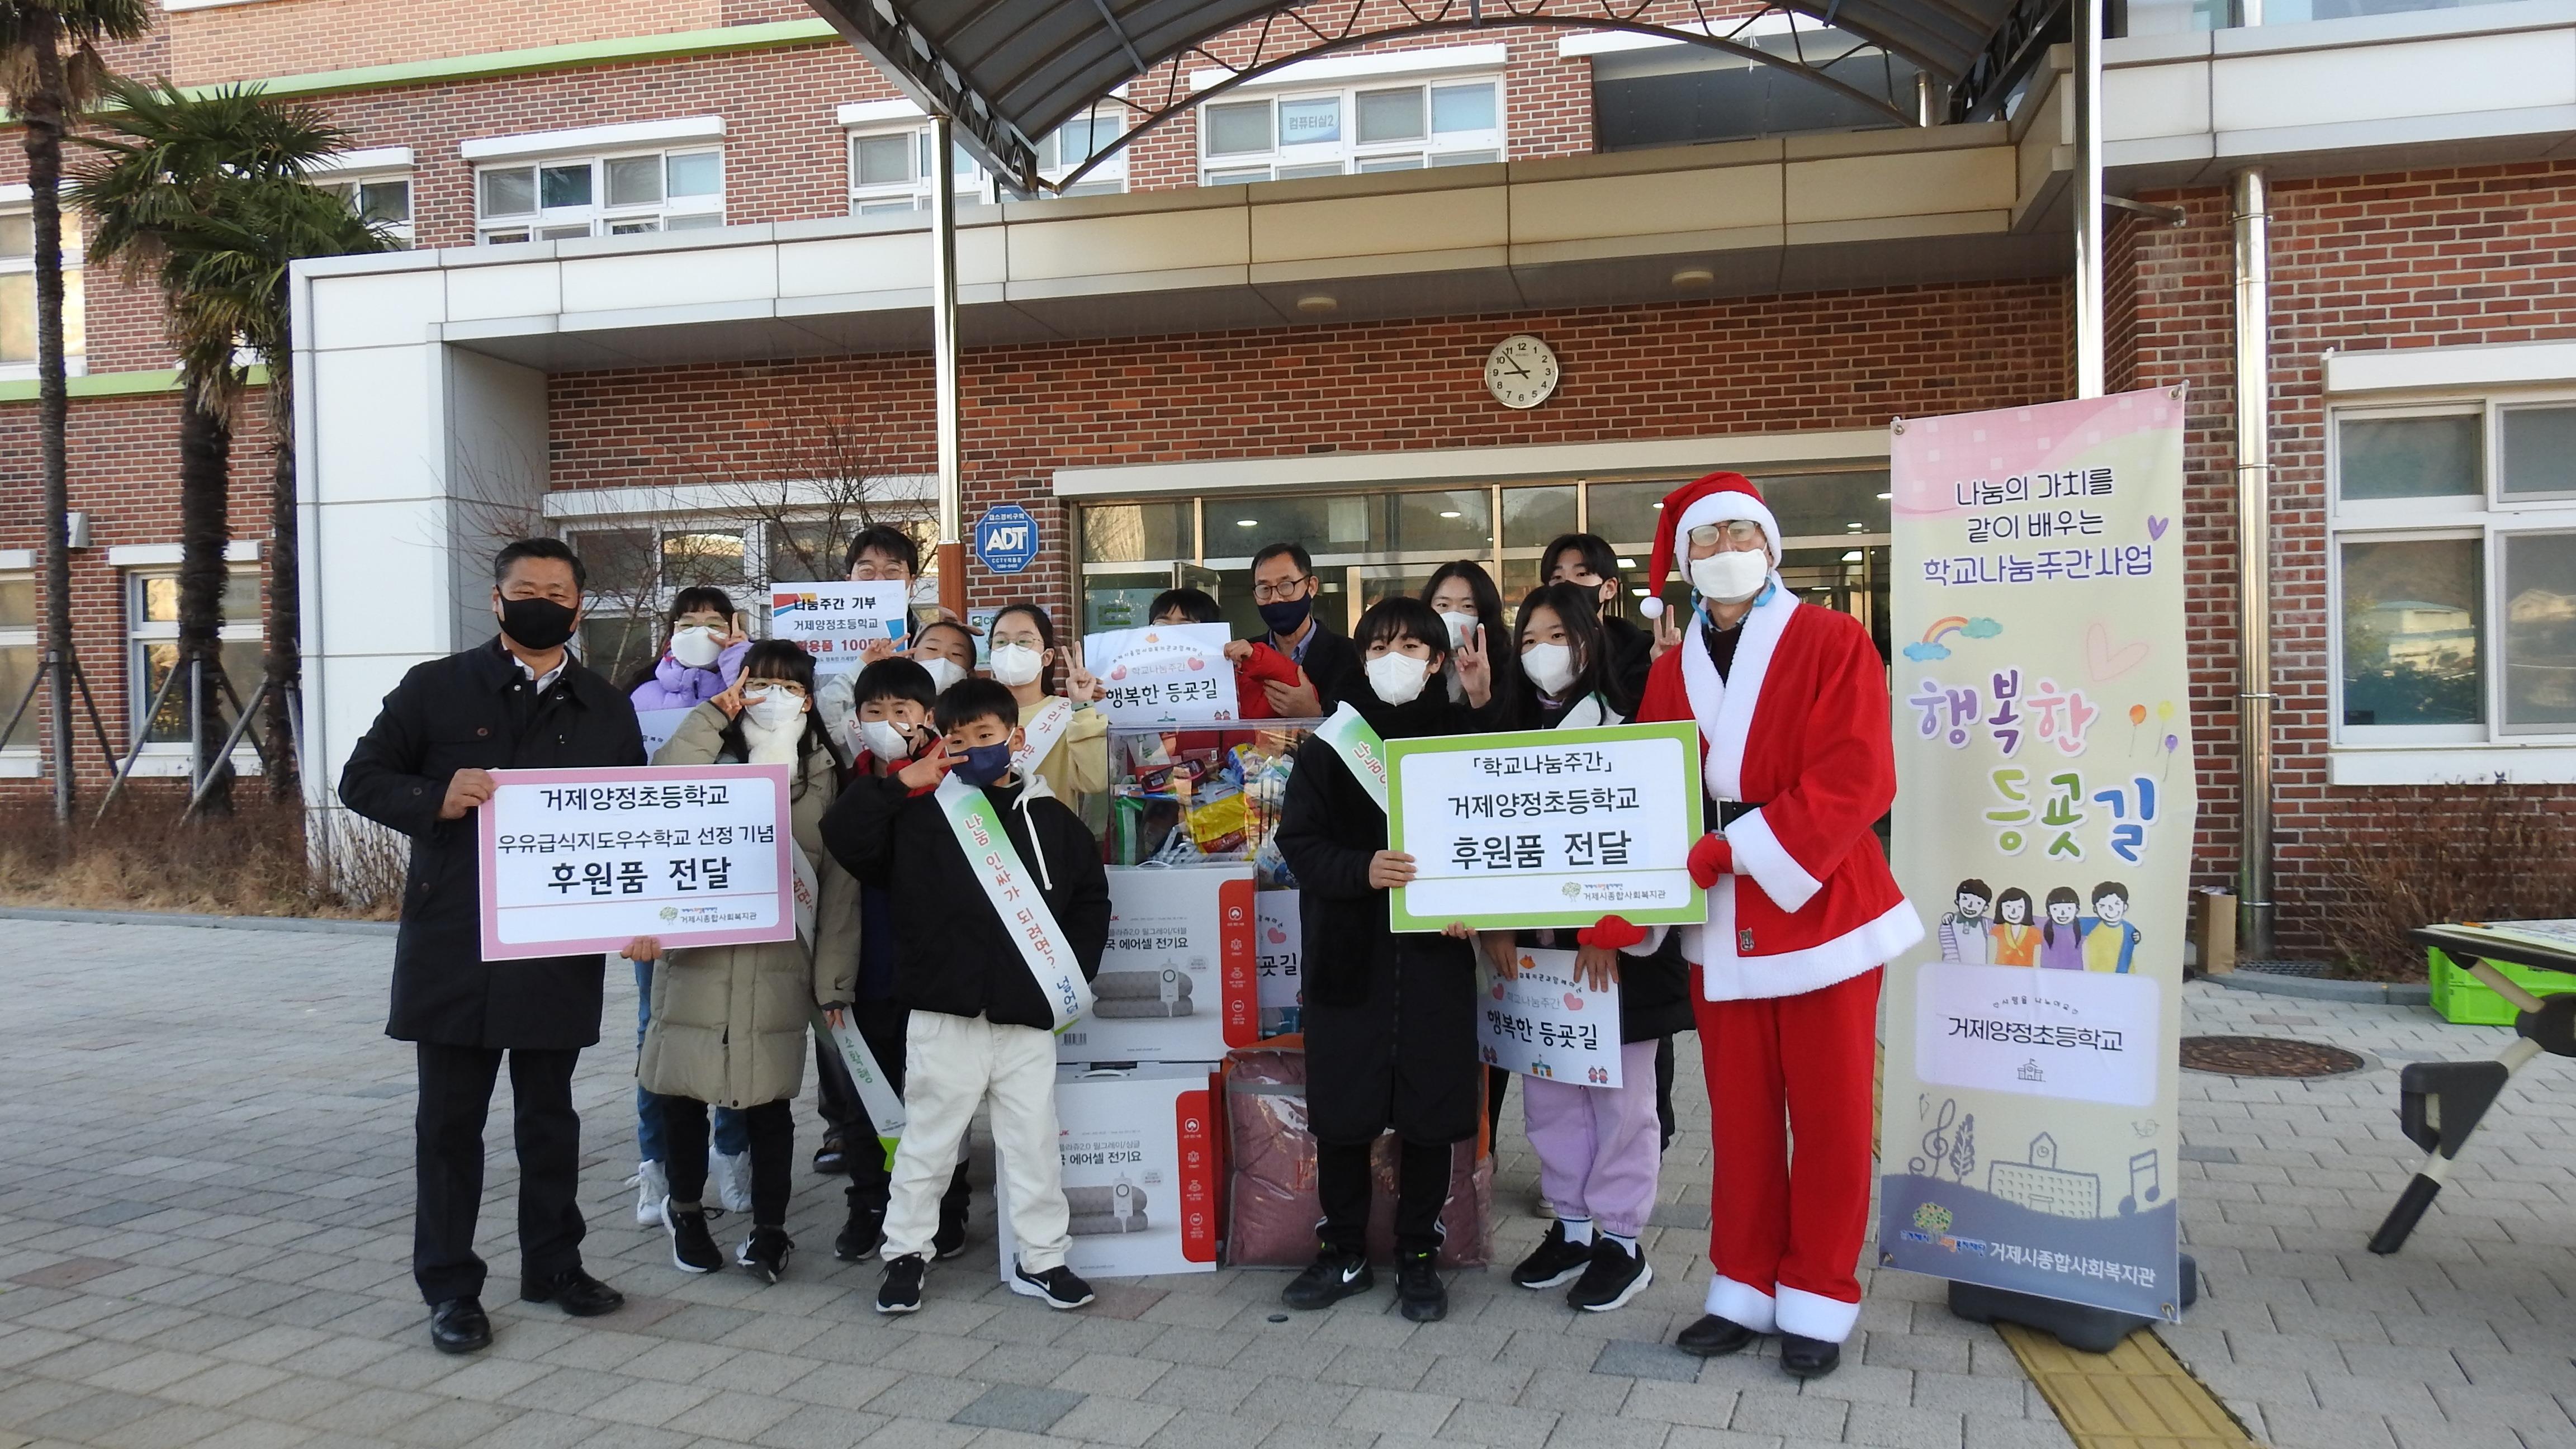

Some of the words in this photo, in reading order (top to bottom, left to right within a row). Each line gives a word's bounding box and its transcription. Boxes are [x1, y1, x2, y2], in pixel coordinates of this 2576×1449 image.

[1289, 115, 1334, 130] 컴퓨터실2
[1957, 476, 2029, 506] 나눔의
[2038, 468, 2113, 499] 가치를
[986, 527, 1027, 551] ADT
[1968, 514, 2019, 543] 같이
[2028, 509, 2104, 538] 배우는
[794, 598, 844, 611] 나눔주간
[852, 596, 876, 609] 기부
[794, 618, 878, 631] 거제양정초등학교
[1132, 662, 1186, 675] 학교나눔주간
[1106, 684, 1159, 708] 행복한
[1166, 678, 1218, 703] 등굣길
[1039, 702, 1069, 733] 우리가
[1909, 669, 2094, 754] 행복한
[1353, 742, 1382, 775] 나눔
[540, 784, 730, 812] 거제양정초등학교
[1448, 787, 1640, 819] 거제양정초등학교
[1986, 769, 2155, 862] 등굣길
[498, 830, 691, 854] 우유급식지도우수학교
[697, 826, 733, 845] 선정
[738, 824, 774, 844] 기념
[1452, 834, 1545, 870] 후원품
[1564, 830, 1632, 866] 전달
[548, 861, 648, 896] 후원품
[669, 856, 732, 892] 전달
[964, 814, 988, 846] 나눔
[986, 851, 1020, 902] 인싸가
[1016, 907, 1056, 969] 되려면?
[1583, 890, 1666, 901] 거제시종합사회복지관
[680, 912, 757, 924] 거제시종합사회복지관
[1105, 939, 1115, 950] 국
[1119, 938, 1152, 950] 에어셀
[1156, 937, 1188, 949] 전기요
[1487, 1010, 1533, 1043] 행복한
[1539, 1021, 1598, 1050] 등굣길
[1948, 1017, 2123, 1052] 거제양정초등학교
[1070, 1152, 1104, 1165] 에어셀
[1108, 1151, 1142, 1163] 전기요
[1990, 1242, 2156, 1287] 거제시종합사회복지관
